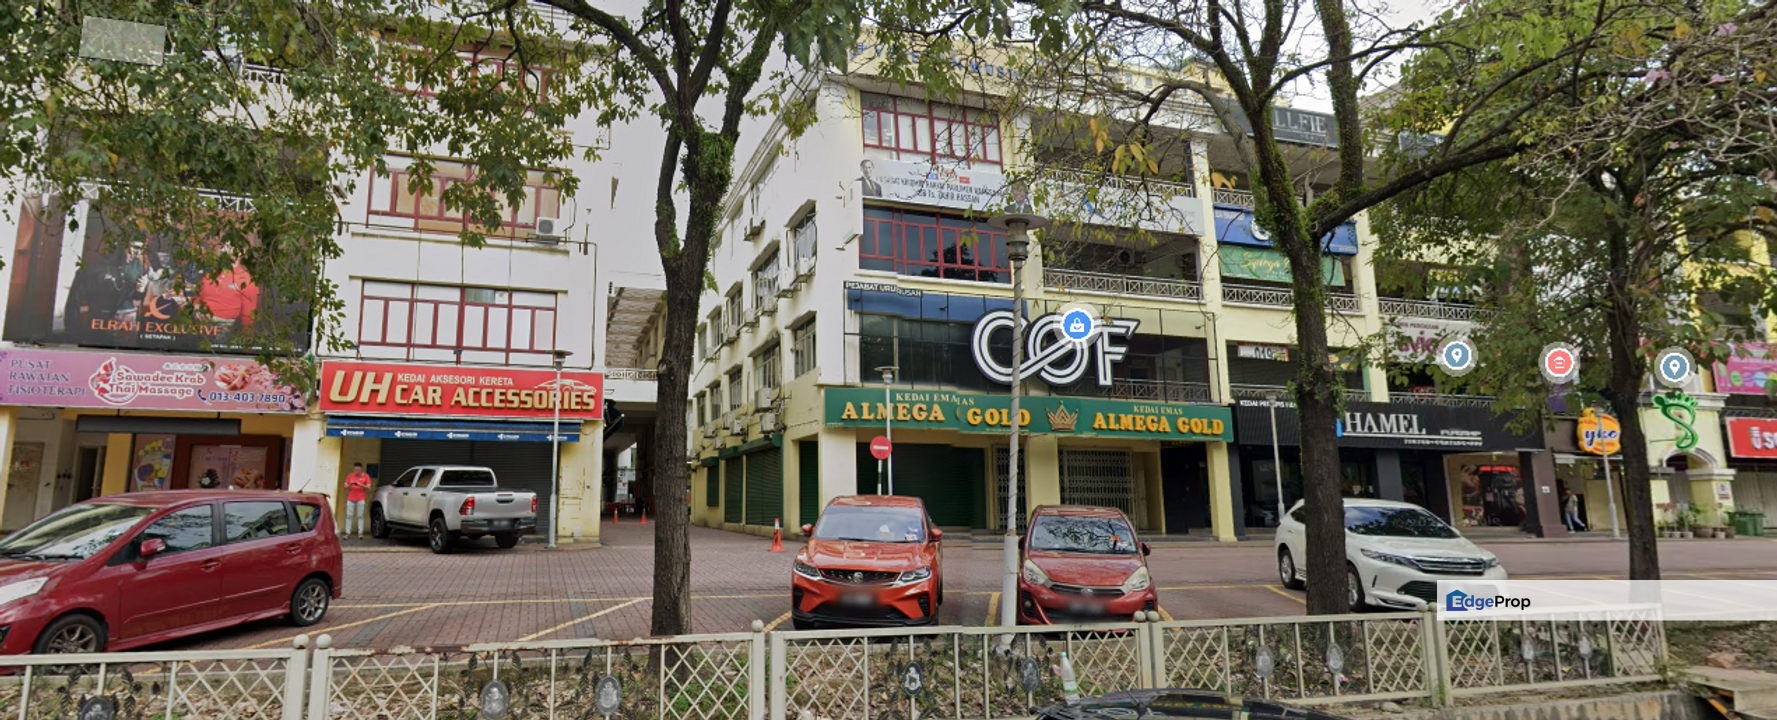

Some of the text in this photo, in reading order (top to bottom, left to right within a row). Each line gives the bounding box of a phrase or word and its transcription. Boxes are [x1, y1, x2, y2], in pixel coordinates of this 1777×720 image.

[846, 281, 878, 292] PEJABAT
[91, 318, 223, 336] ELRAH EXCLUSIVE
[11, 359, 51, 370] PUSAT
[10, 371, 70, 382] RAWATAN
[117, 371, 205, 384] Sawadee Krab
[398, 373, 514, 386] KEDAI AKSESORI KERETA
[9, 384, 86, 396] FISIOTERAPI
[109, 383, 193, 398] Thai Massage
[329, 370, 394, 404] UH
[258, 393, 286, 403] 7890
[394, 385, 596, 411] CAR ACCESSORIES
[896, 393, 930, 402] KEDAI
[842, 401, 1031, 426] ALMEGA GOLD
[1133, 405, 1183, 415] KEDAI EMAS
[1093, 412, 1224, 435] ALMEGA GOLD
[1345, 412, 1427, 434] HAMEL
